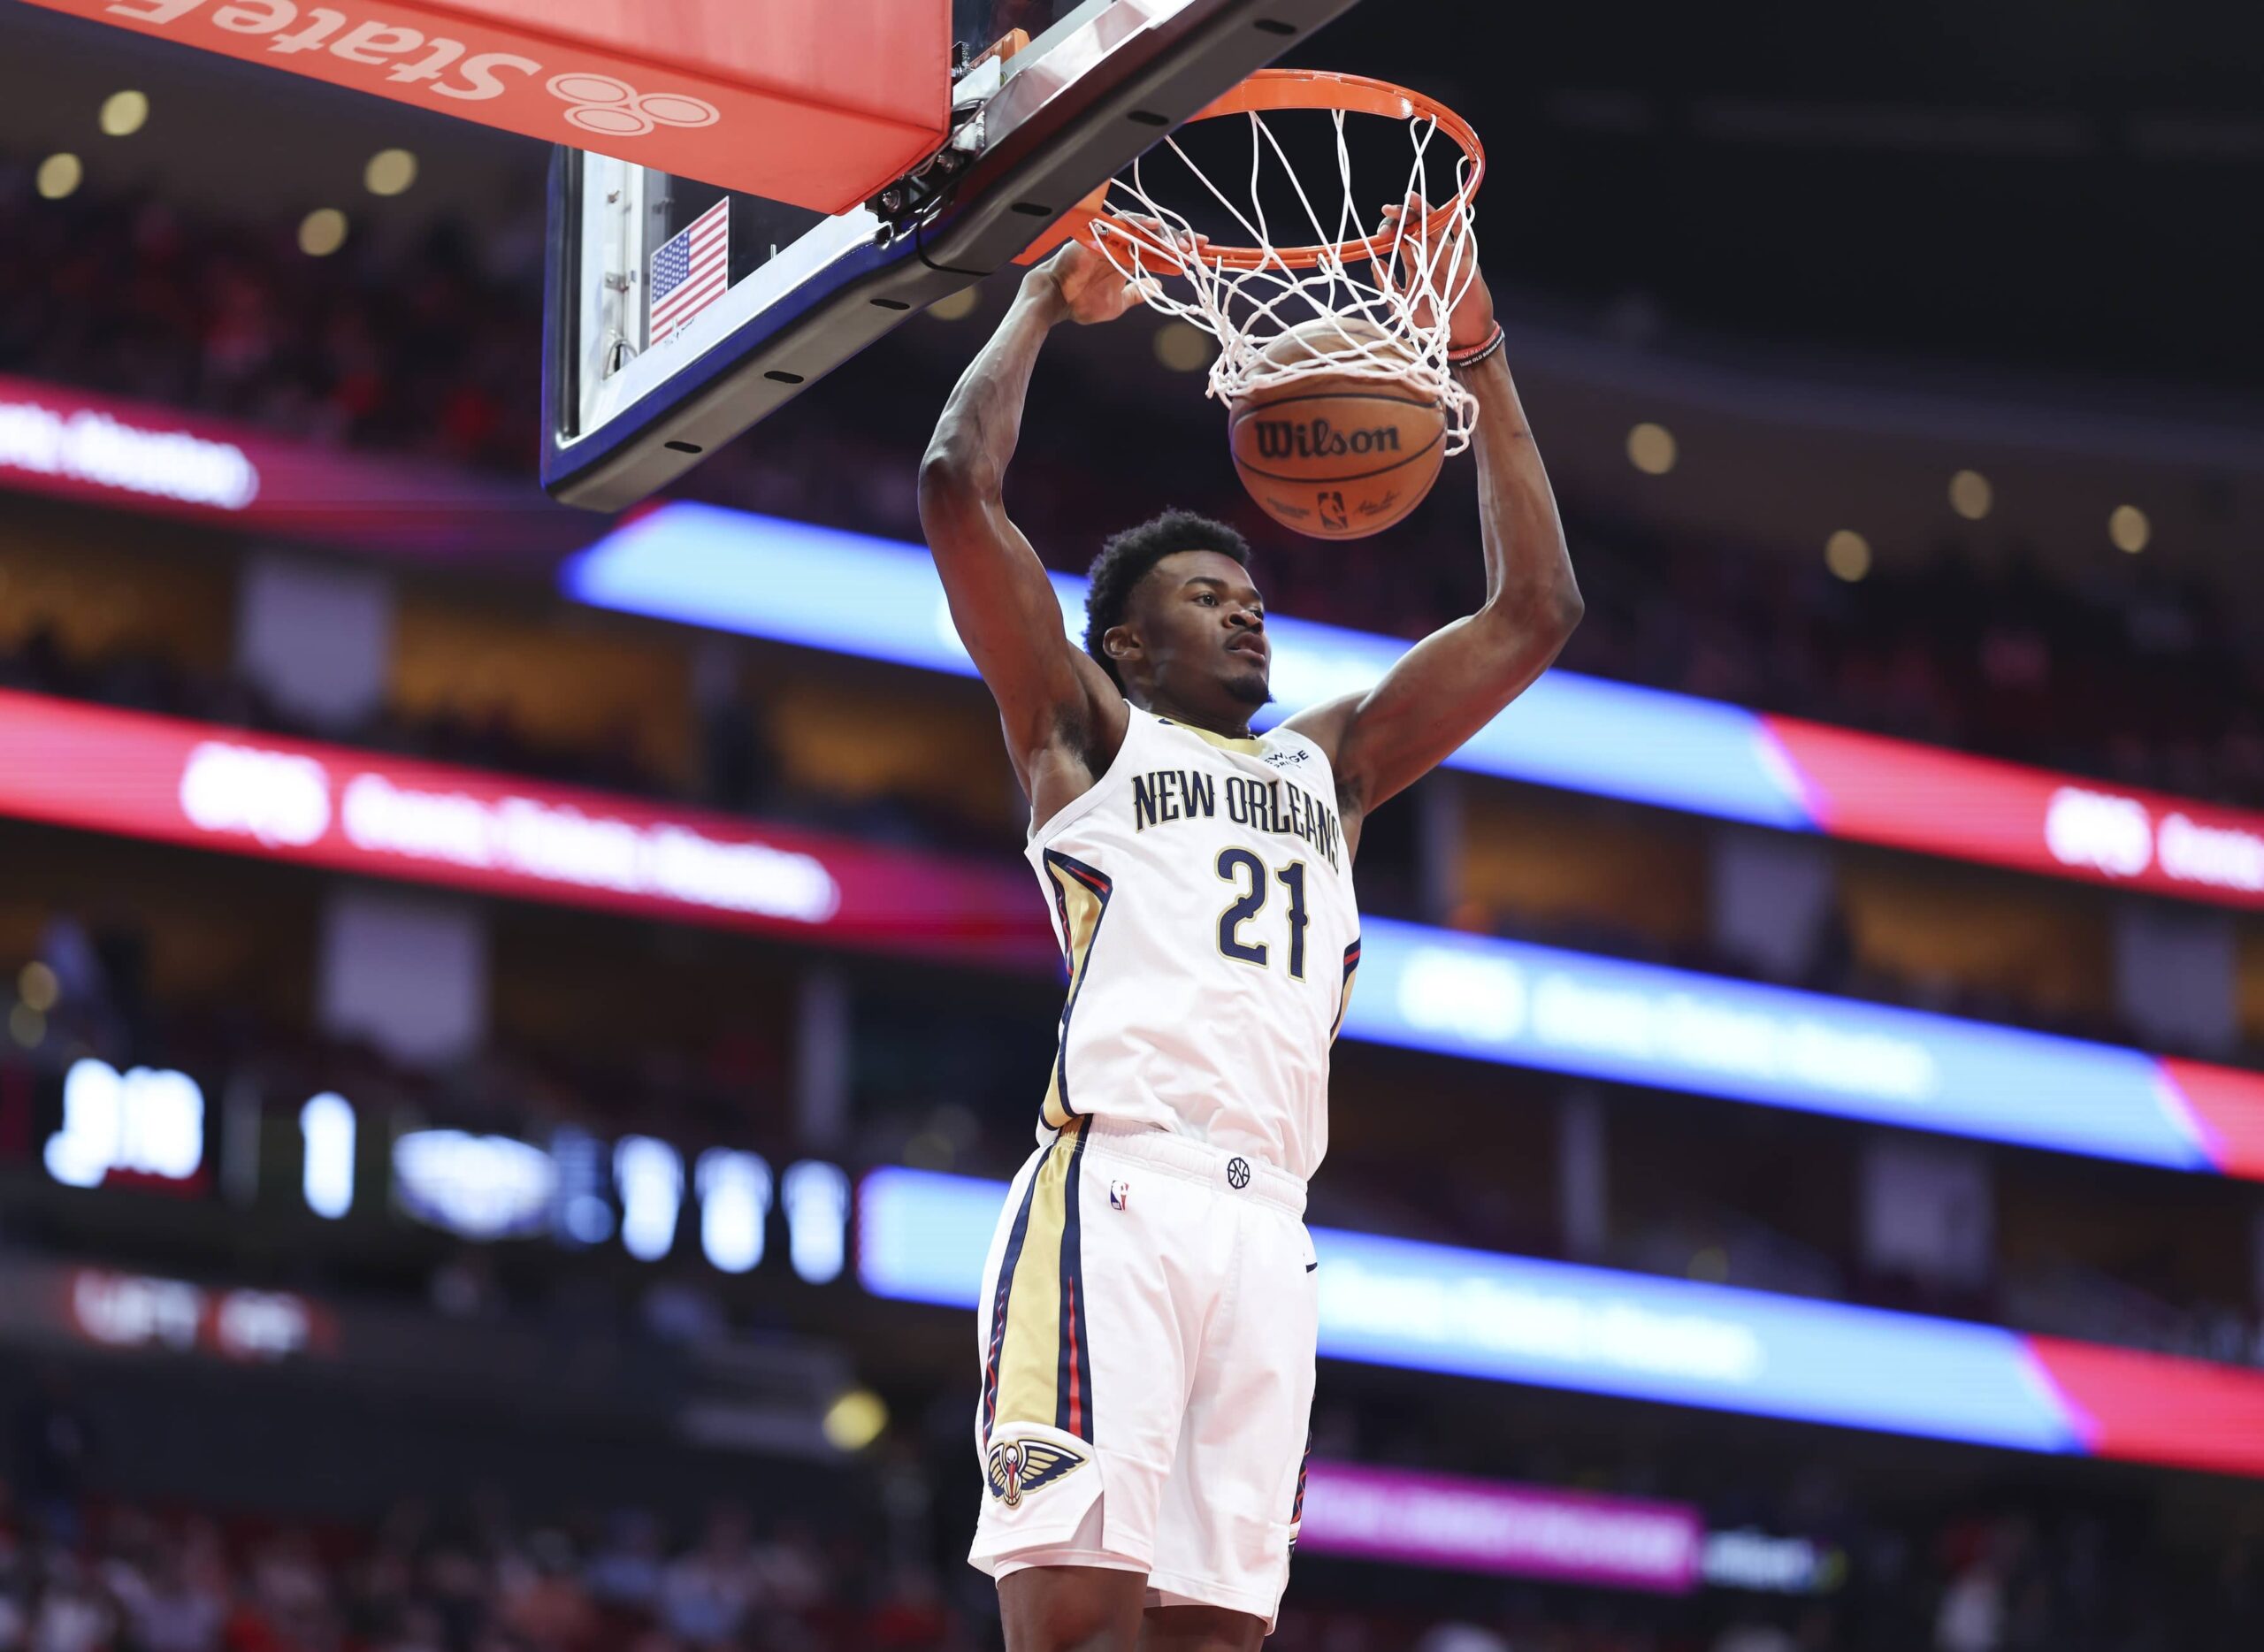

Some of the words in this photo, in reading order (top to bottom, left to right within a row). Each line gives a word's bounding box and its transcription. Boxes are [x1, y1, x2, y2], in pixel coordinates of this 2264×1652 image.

[1256, 418, 1401, 458] Wilson
[1132, 770, 1216, 833] NEW
[1225, 776, 1340, 876] ORLEANS
[1214, 845, 1310, 983] 21
